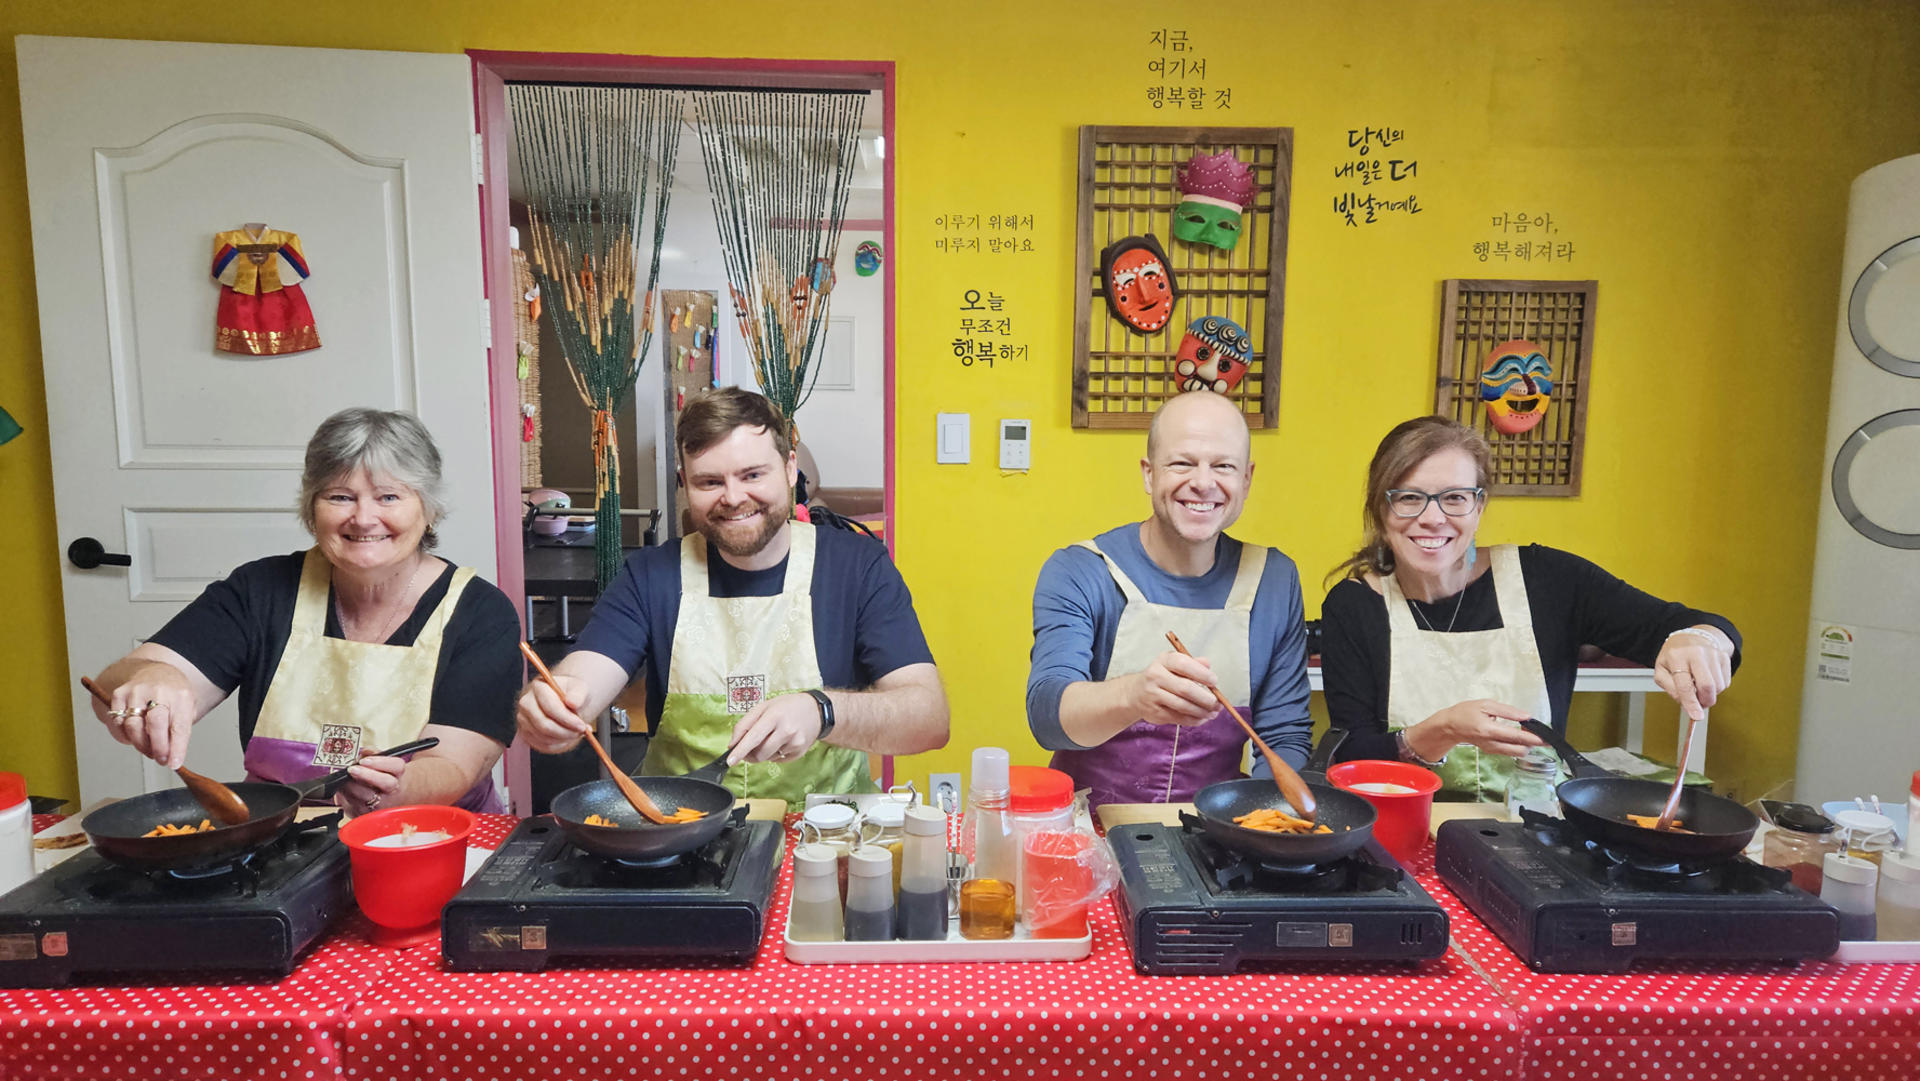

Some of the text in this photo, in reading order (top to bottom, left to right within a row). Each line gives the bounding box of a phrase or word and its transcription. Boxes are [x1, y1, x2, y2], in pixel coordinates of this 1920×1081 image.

[1150, 28, 1193, 53] 지금,
[1147, 57, 1207, 81] 여기서
[1146, 85, 1232, 110] 행복할 것
[1347, 126, 1405, 156] 당신의
[1334, 158, 1418, 186] 내일은 더
[934, 214, 1034, 232] 이루기 위해서
[1491, 212, 1559, 234] 마음아,
[934, 236, 1035, 254] 미루지 말아요
[1472, 240, 1576, 263] 행복해져라
[959, 288, 1005, 312] 오늘
[959, 317, 1012, 337] 무조건
[951, 338, 1029, 369] 행복하기
